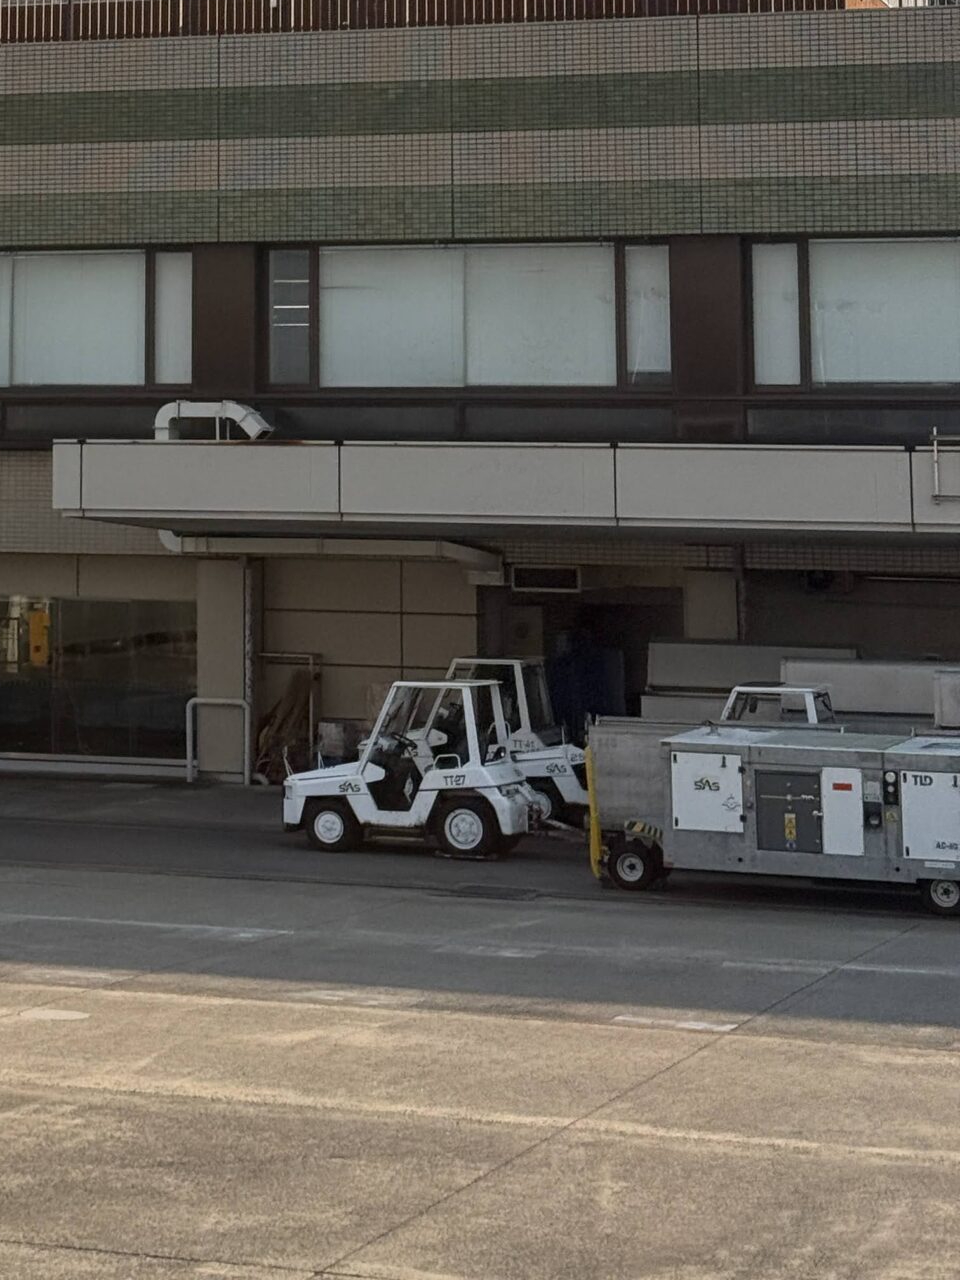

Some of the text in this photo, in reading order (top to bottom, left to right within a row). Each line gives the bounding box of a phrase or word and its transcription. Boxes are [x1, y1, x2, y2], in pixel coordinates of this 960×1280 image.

[338, 781, 361, 793] SAS
[443, 774, 466, 787] TT-27
[694, 777, 720, 792] SAS
[912, 774, 933, 787] TLD
